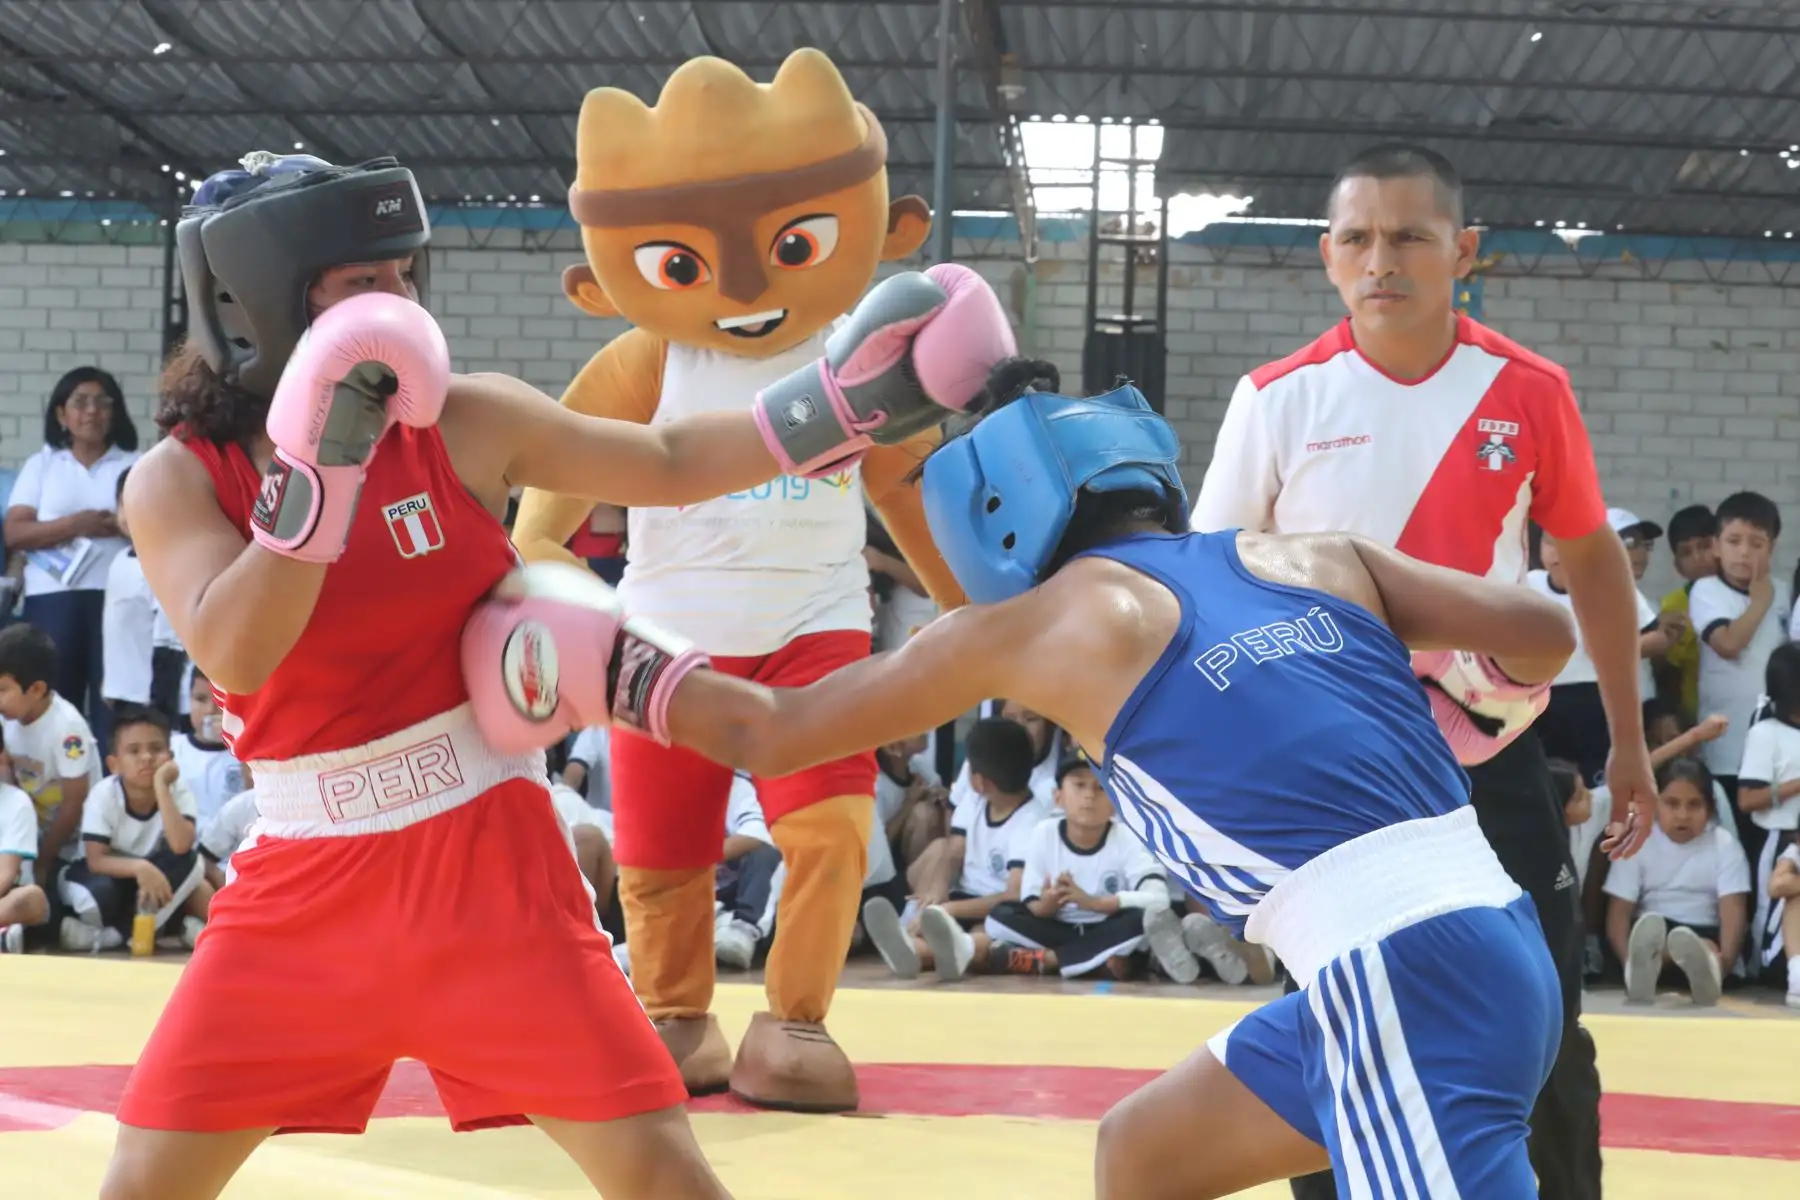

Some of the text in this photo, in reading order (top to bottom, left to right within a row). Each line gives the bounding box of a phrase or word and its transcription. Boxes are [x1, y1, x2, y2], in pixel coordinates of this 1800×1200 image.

[388, 498, 426, 519] PERU
[727, 474, 810, 500] 019
[1193, 606, 1344, 692] PERÚ
[322, 743, 458, 819] PER
